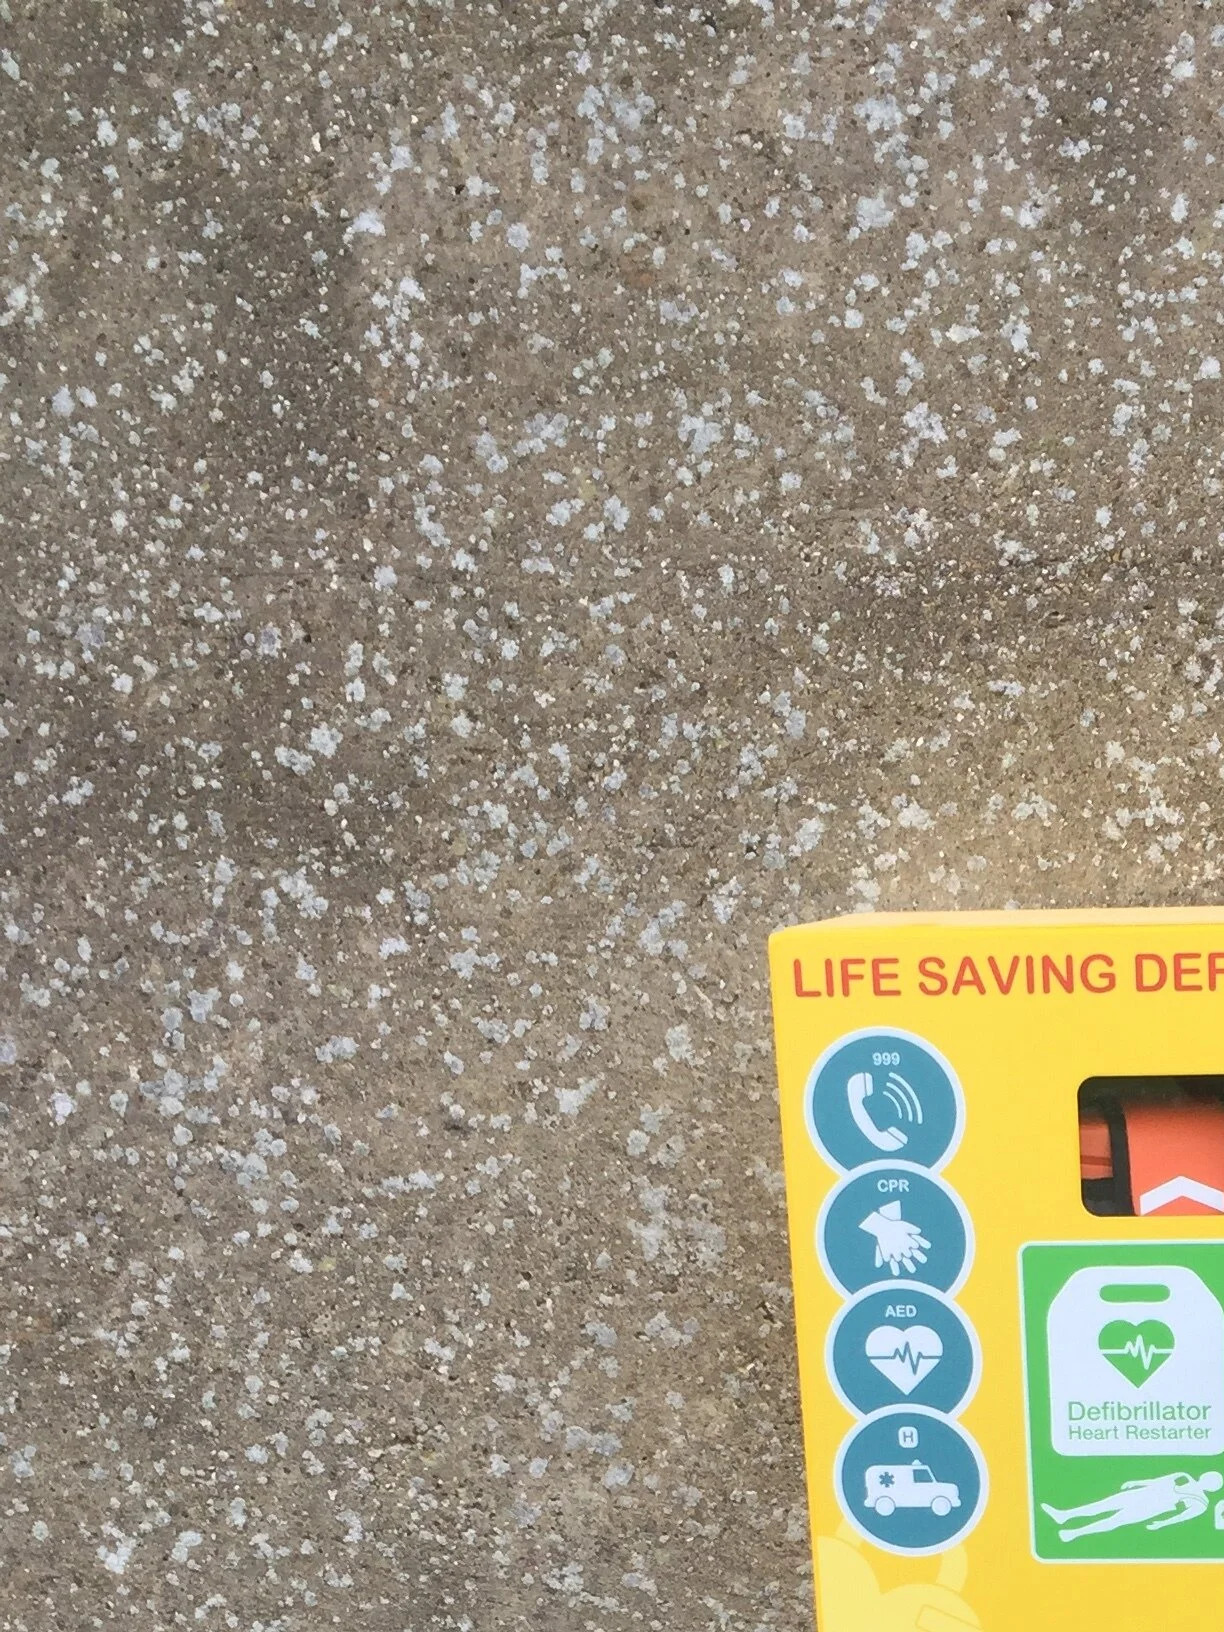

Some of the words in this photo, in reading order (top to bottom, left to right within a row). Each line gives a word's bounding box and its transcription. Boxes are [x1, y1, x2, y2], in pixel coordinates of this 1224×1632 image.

[794, 957, 901, 998] LIFE
[918, 954, 1117, 997] SAVING
[872, 1052, 900, 1066] 999
[877, 1179, 910, 1193] CPR
[885, 1304, 917, 1318] AED
[1068, 1401, 1212, 1421] Defibrillator
[903, 1430, 914, 1443] H
[1068, 1425, 1119, 1440] Heart
[1126, 1424, 1212, 1440] Restarter
